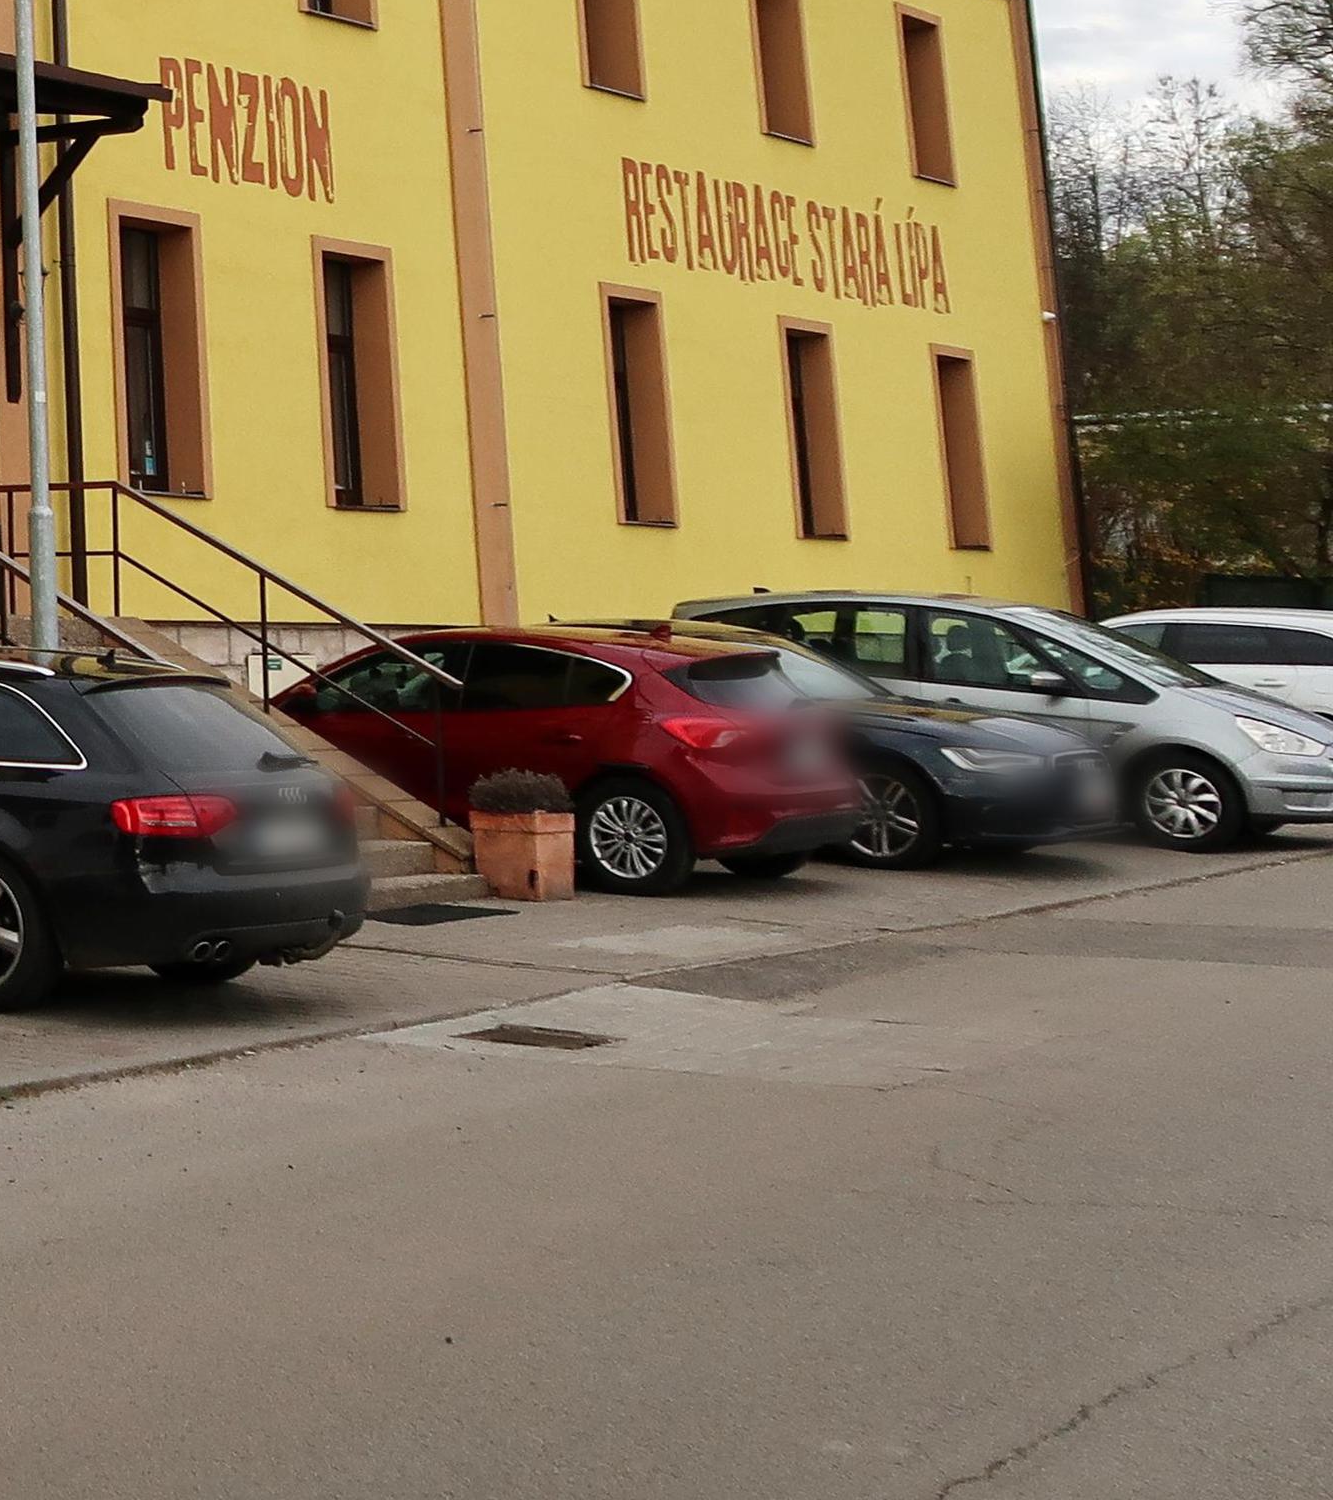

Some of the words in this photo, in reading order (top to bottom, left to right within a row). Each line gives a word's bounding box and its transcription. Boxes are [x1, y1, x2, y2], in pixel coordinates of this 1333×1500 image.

[159, 56, 334, 204] PENZION
[621, 157, 805, 287] RESTAURACE
[806, 197, 895, 308] STARÁ
[893, 205, 952, 314] LÍPA
